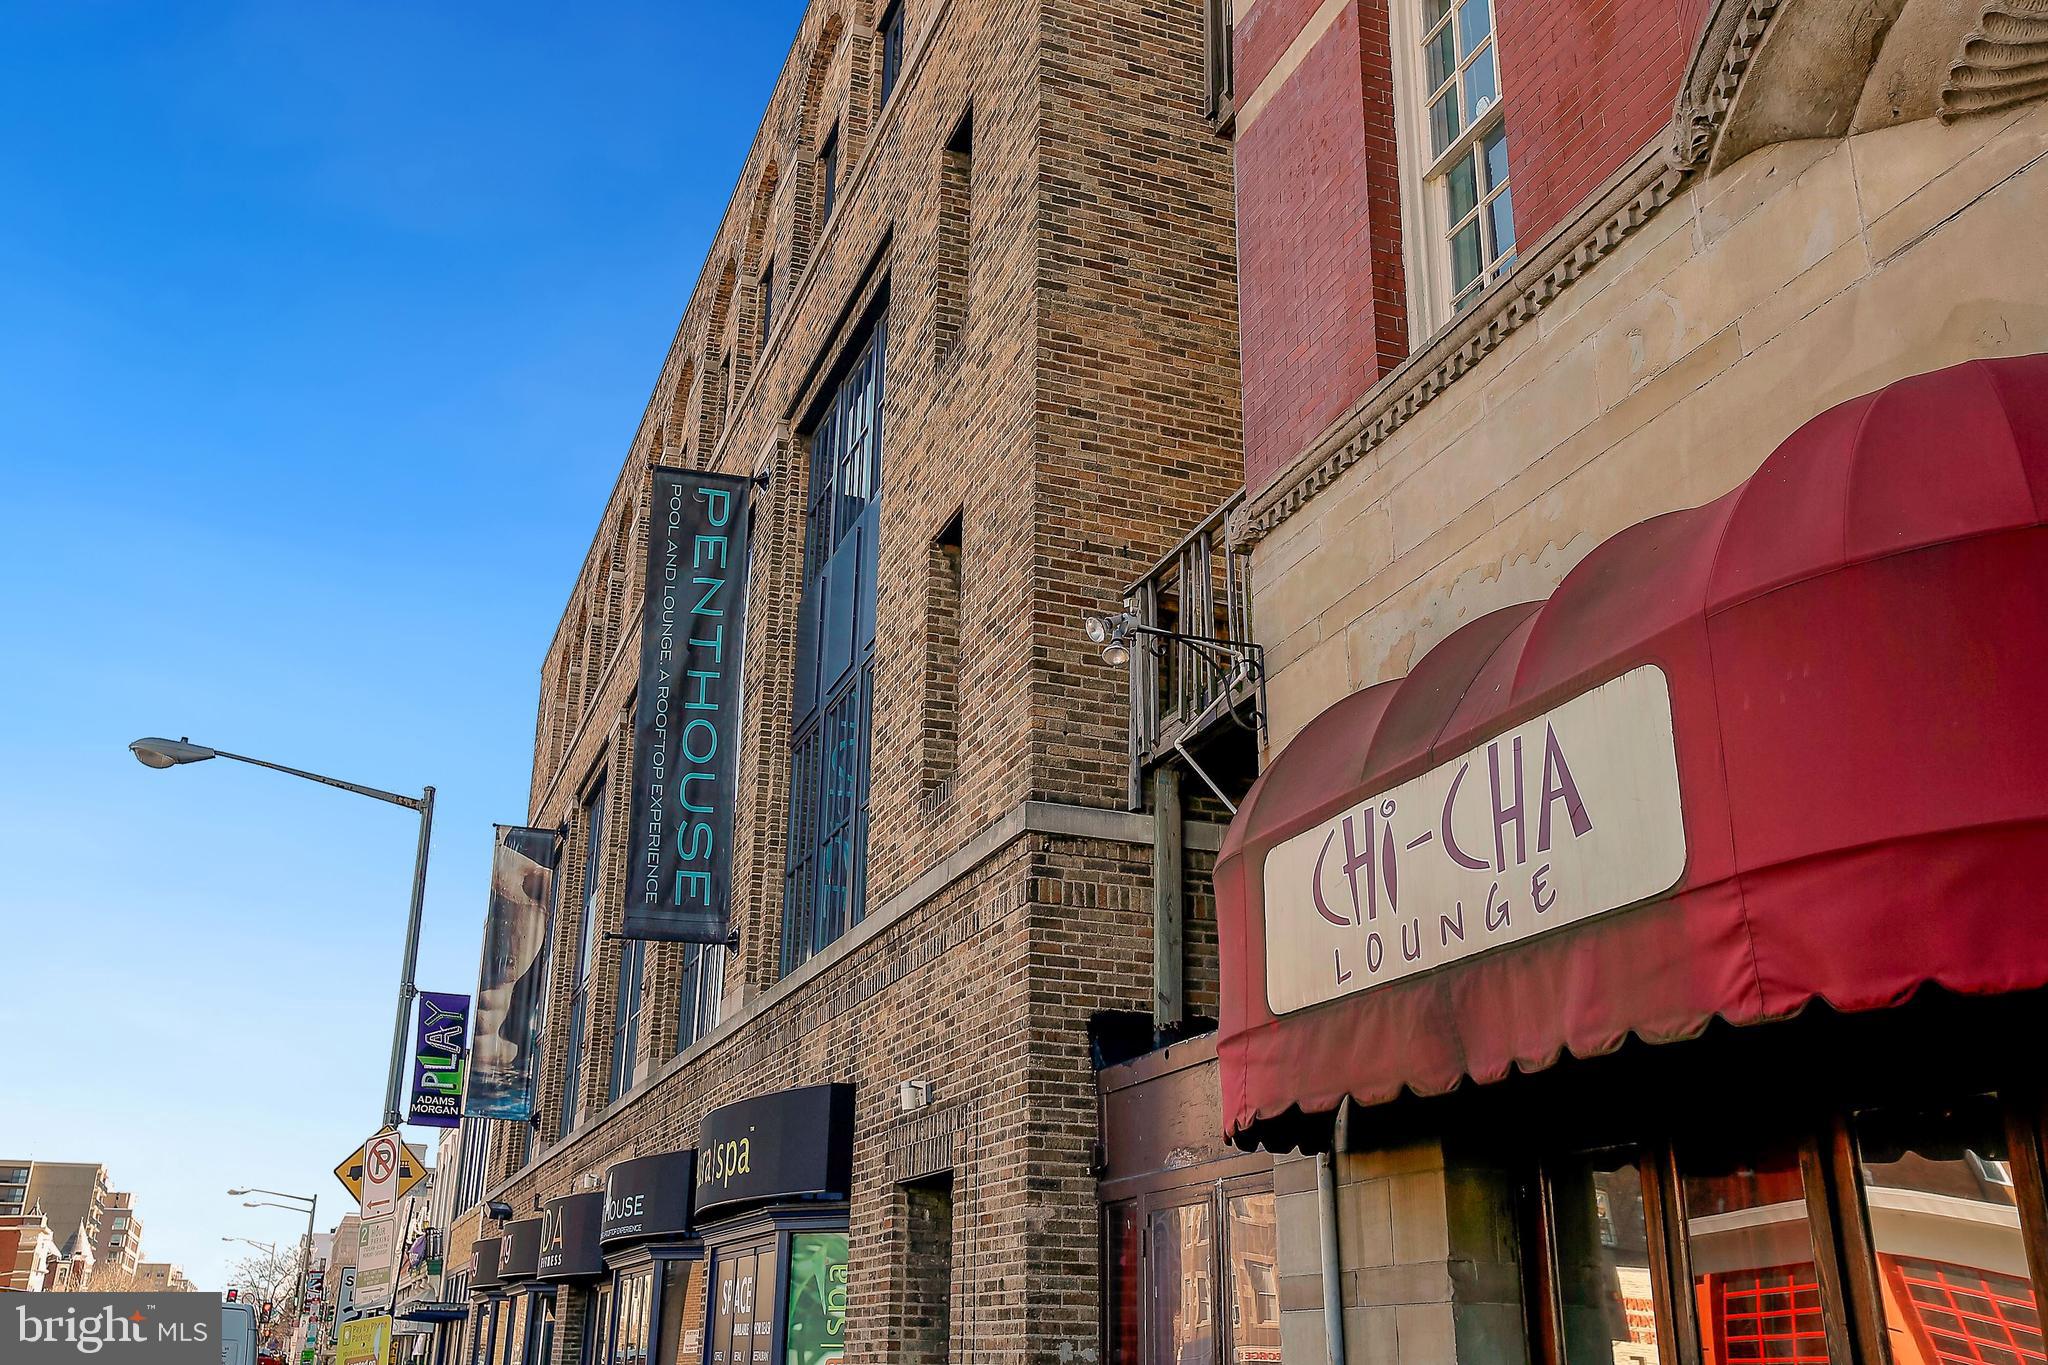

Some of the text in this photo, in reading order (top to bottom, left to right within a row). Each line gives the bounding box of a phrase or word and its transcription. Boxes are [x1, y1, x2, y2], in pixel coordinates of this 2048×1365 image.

[667, 484, 682, 537] POOL
[665, 539, 679, 581] AND
[658, 669, 671, 683] A
[674, 487, 731, 906] PENTHOUSE
[652, 686, 669, 780] ROOFTOP
[645, 783, 663, 904] EXPERIENCE
[1335, 863, 1557, 985] LOUNGE
[421, 1000, 464, 1087] PLAY
[410, 1103, 459, 1116] MORGAN
[416, 1095, 456, 1106] ADAMS
[361, 1227, 368, 1243] 2
[722, 1276, 753, 1316] SPACE
